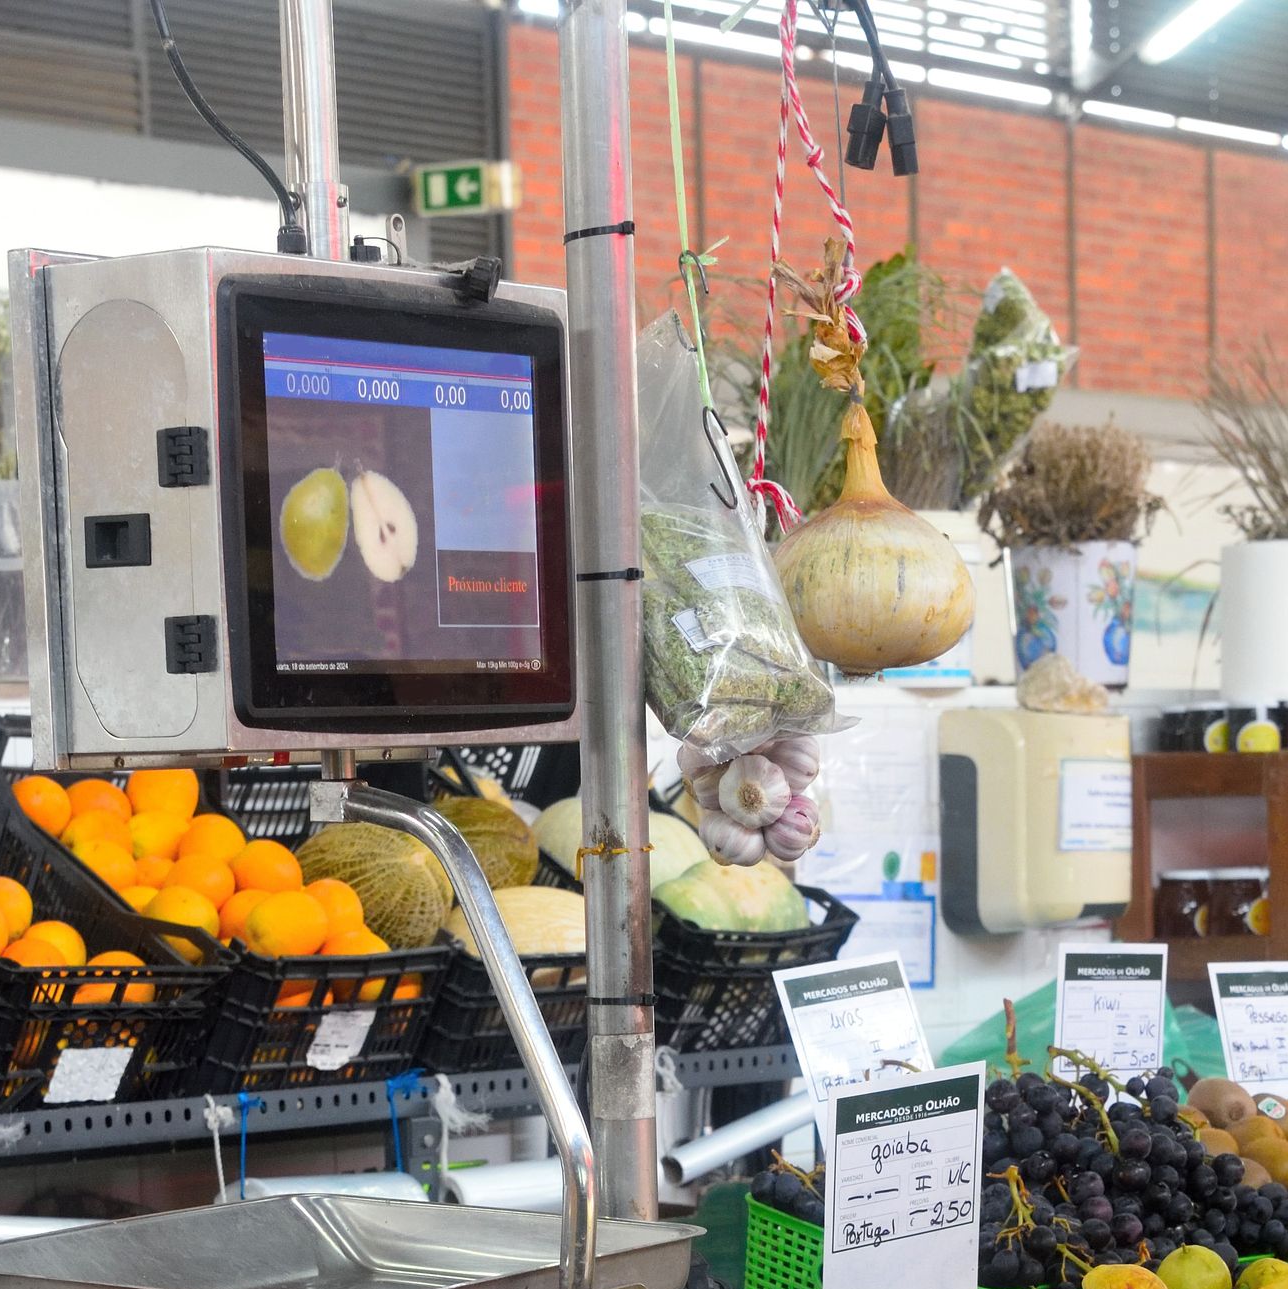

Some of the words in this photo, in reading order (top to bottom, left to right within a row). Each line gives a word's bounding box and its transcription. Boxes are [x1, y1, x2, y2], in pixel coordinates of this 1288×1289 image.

[287, 373, 330, 395] 0,000
[358, 378, 400, 400] 0,000
[435, 384, 466, 407] 0,00
[501, 390, 530, 412] 0,00
[448, 576, 491, 594] Próximo
[494, 577, 528, 593] cliente
[803, 985, 848, 1001] MERCADOS
[850, 983, 858, 991] DE
[855, 1106, 910, 1124] MERCADOS
[913, 1104, 923, 1112] DE
[925, 1096, 960, 1111] OLHÃO
[894, 1114, 913, 1123] DESDE
[871, 1131, 932, 1174] goiaba
[843, 1219, 895, 1248] Portugal
[930, 1201, 972, 1227] 2,50
